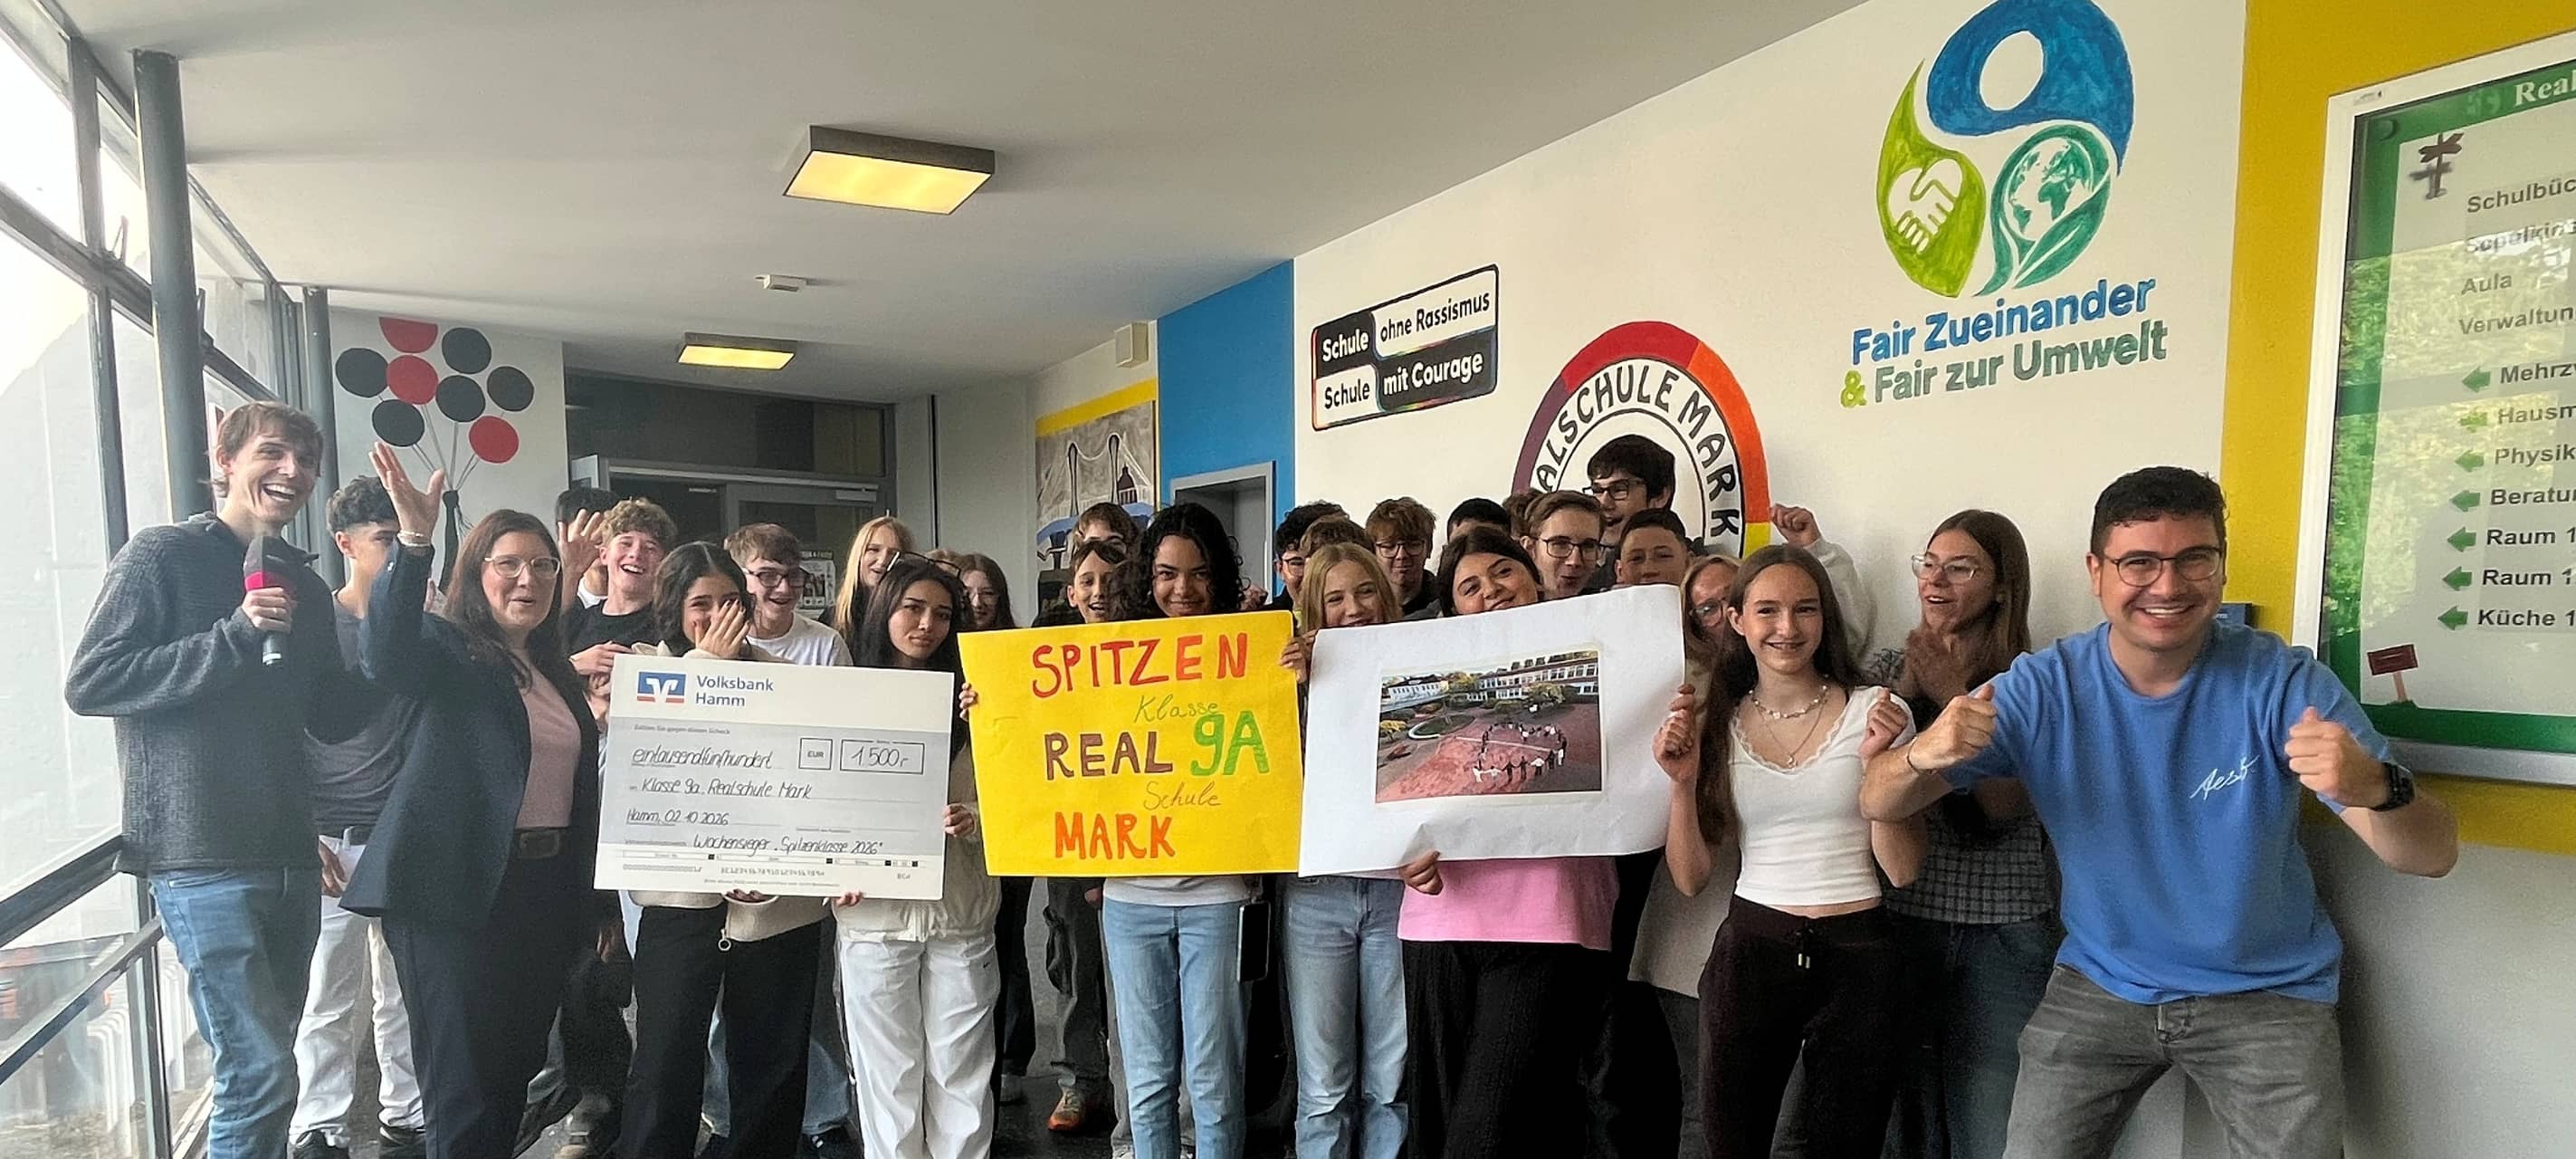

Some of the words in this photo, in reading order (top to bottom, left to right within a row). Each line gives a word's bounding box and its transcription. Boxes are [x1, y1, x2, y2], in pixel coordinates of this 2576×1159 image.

[2466, 178, 2576, 213] Schulbüc
[2461, 273, 2513, 295] Aula
[1322, 328, 1369, 362] Schule
[1380, 319, 1412, 342] ohne
[1416, 292, 1491, 332] Rassismus
[1852, 321, 1916, 366] Fair
[1923, 279, 2156, 352] Zueinander
[2457, 306, 2576, 335] Verwaltun
[1840, 369, 1867, 409] &
[1875, 359, 1938, 404] Fair
[1945, 355, 2004, 392] zur
[2013, 319, 2169, 381] Umwelt
[2500, 363, 2576, 384] Mehrz
[1324, 378, 1370, 409] Schule
[1383, 367, 1409, 396] mit
[1411, 352, 1484, 384] Courage
[1536, 364, 1680, 493] ALSCHULE
[1676, 389, 1741, 538] MARK
[2495, 444, 2576, 468] Physik
[2486, 529, 2557, 546] Raum
[2482, 569, 2552, 586] Raum
[2476, 608, 2556, 627] Küche
[1032, 632, 1248, 699] SPITZEN
[695, 675, 775, 692] Volksbank
[695, 692, 746, 707] Hamm
[1133, 693, 1219, 723] Klasse
[806, 750, 825, 759] EUR
[1044, 731, 1174, 781] REAL
[1189, 710, 1271, 777] 9A
[641, 777, 682, 794] Klasse
[707, 778, 774, 798] Realschule
[778, 781, 813, 800] Mark
[1142, 781, 1222, 811] Schule
[692, 833, 771, 858] Wochensieger
[1054, 811, 1177, 860] MARK
